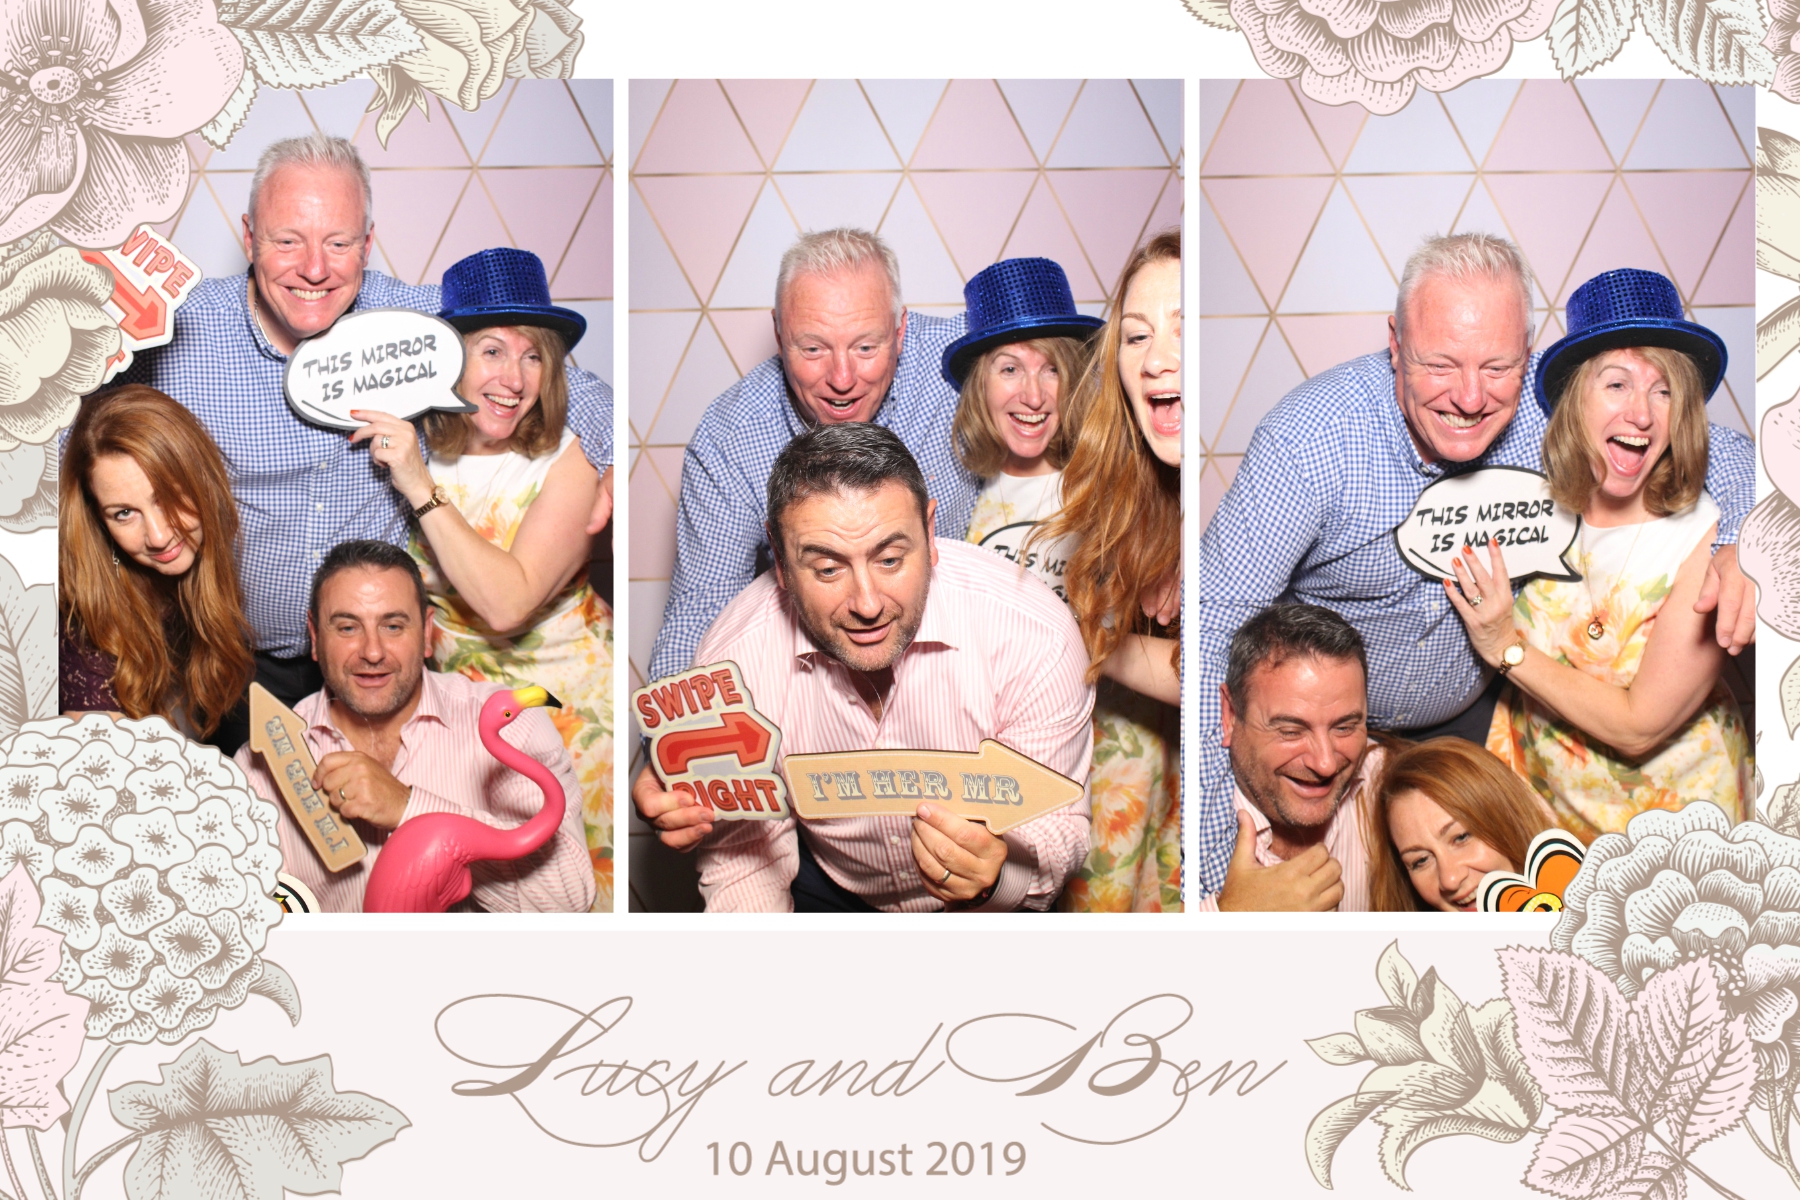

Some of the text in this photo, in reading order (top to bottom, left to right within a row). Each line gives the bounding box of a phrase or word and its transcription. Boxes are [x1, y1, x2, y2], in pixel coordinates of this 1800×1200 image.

[120, 226, 194, 299] WIPE
[303, 334, 437, 378] THIS MIRROR
[322, 360, 437, 402] IS MAGICAL
[1417, 499, 1555, 526] THIS MIRROR
[1430, 525, 1549, 553] IS MAGICAL
[637, 668, 743, 728] SWIPE
[264, 715, 349, 856] I'M HER MR
[806, 769, 1024, 806] I'M HER MR
